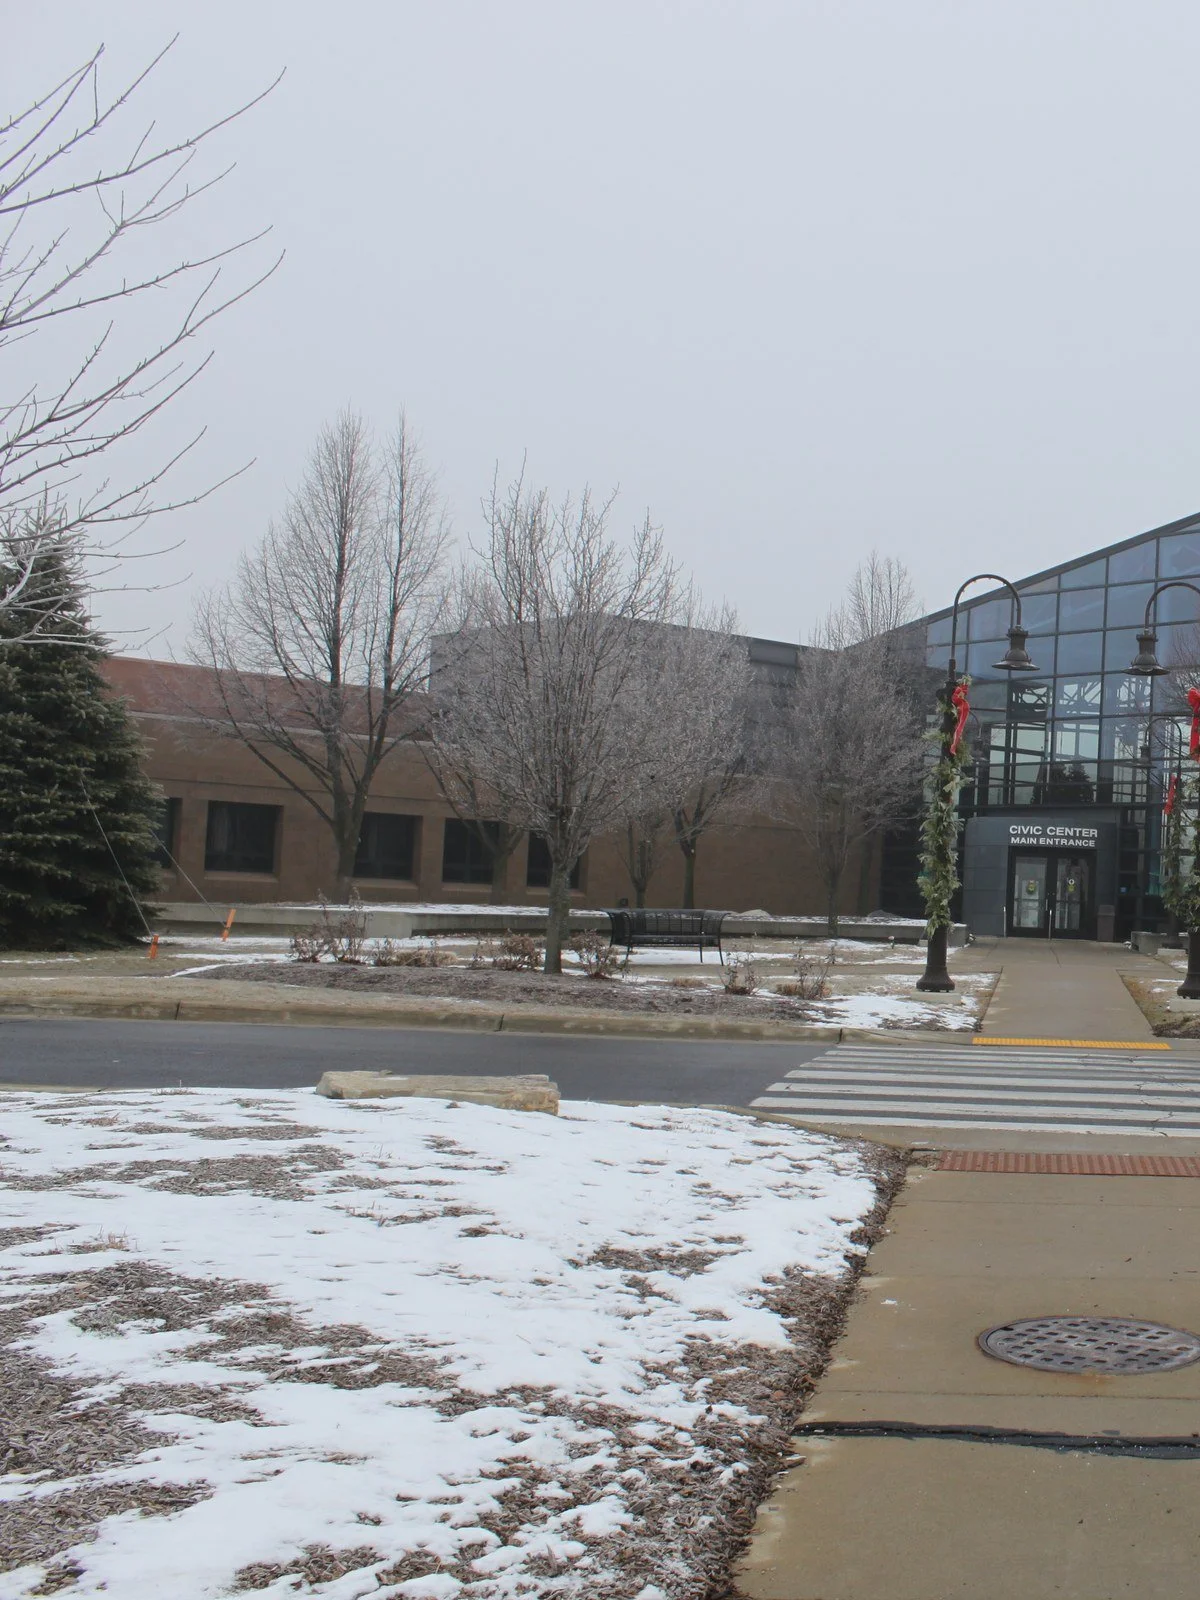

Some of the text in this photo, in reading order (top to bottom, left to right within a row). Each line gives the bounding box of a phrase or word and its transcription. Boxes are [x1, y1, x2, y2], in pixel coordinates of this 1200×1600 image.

[1009, 825, 1098, 838] CIVIC CENTER
[1010, 837, 1096, 847] MAIN ENTRANCE
